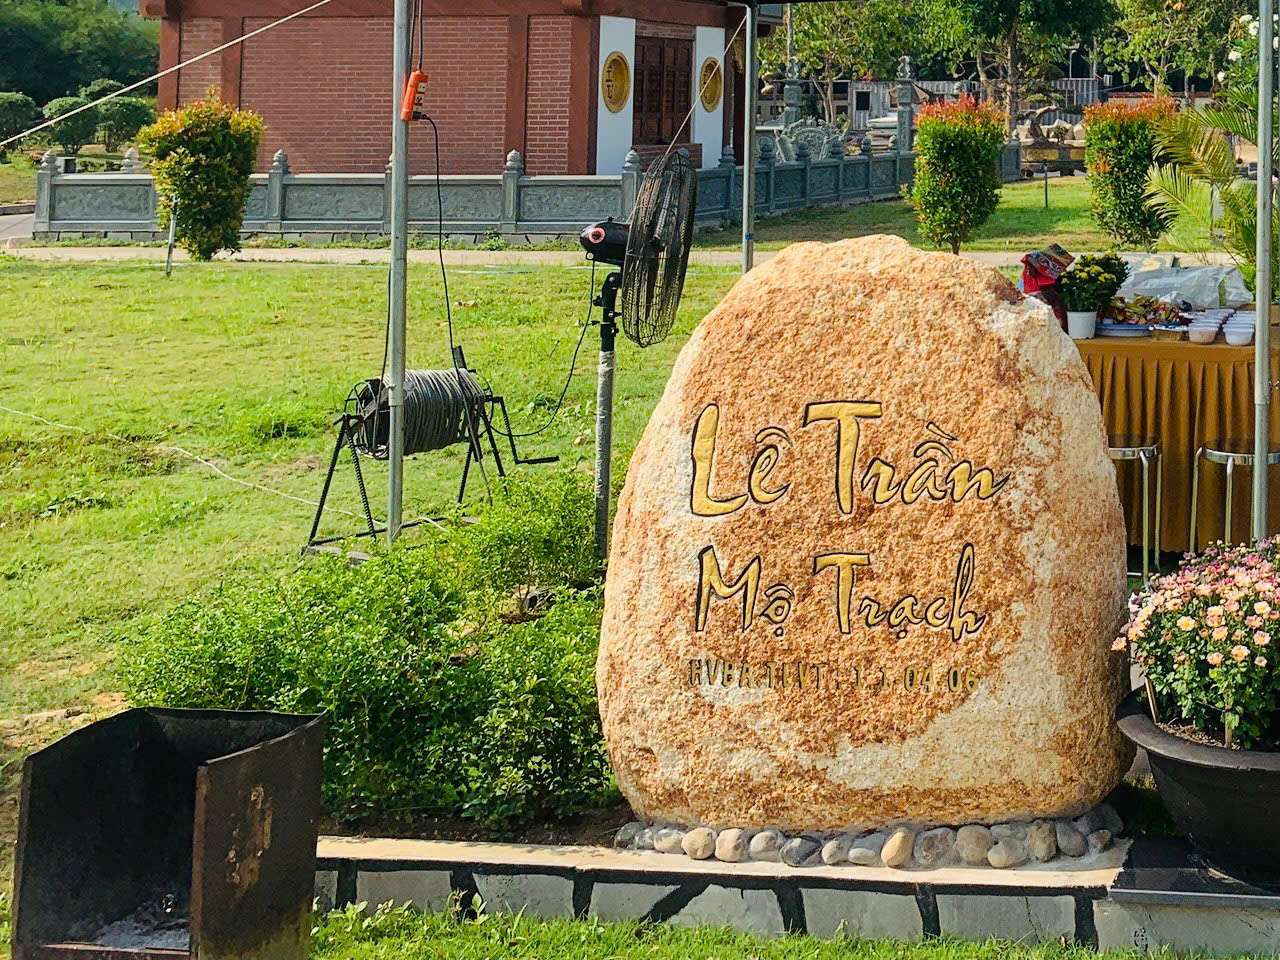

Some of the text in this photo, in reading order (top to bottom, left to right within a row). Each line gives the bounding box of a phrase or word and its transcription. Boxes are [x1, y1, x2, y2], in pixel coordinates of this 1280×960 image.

[690, 399, 1010, 518] Lê Trần
[695, 541, 987, 641] Mộ Trạch
